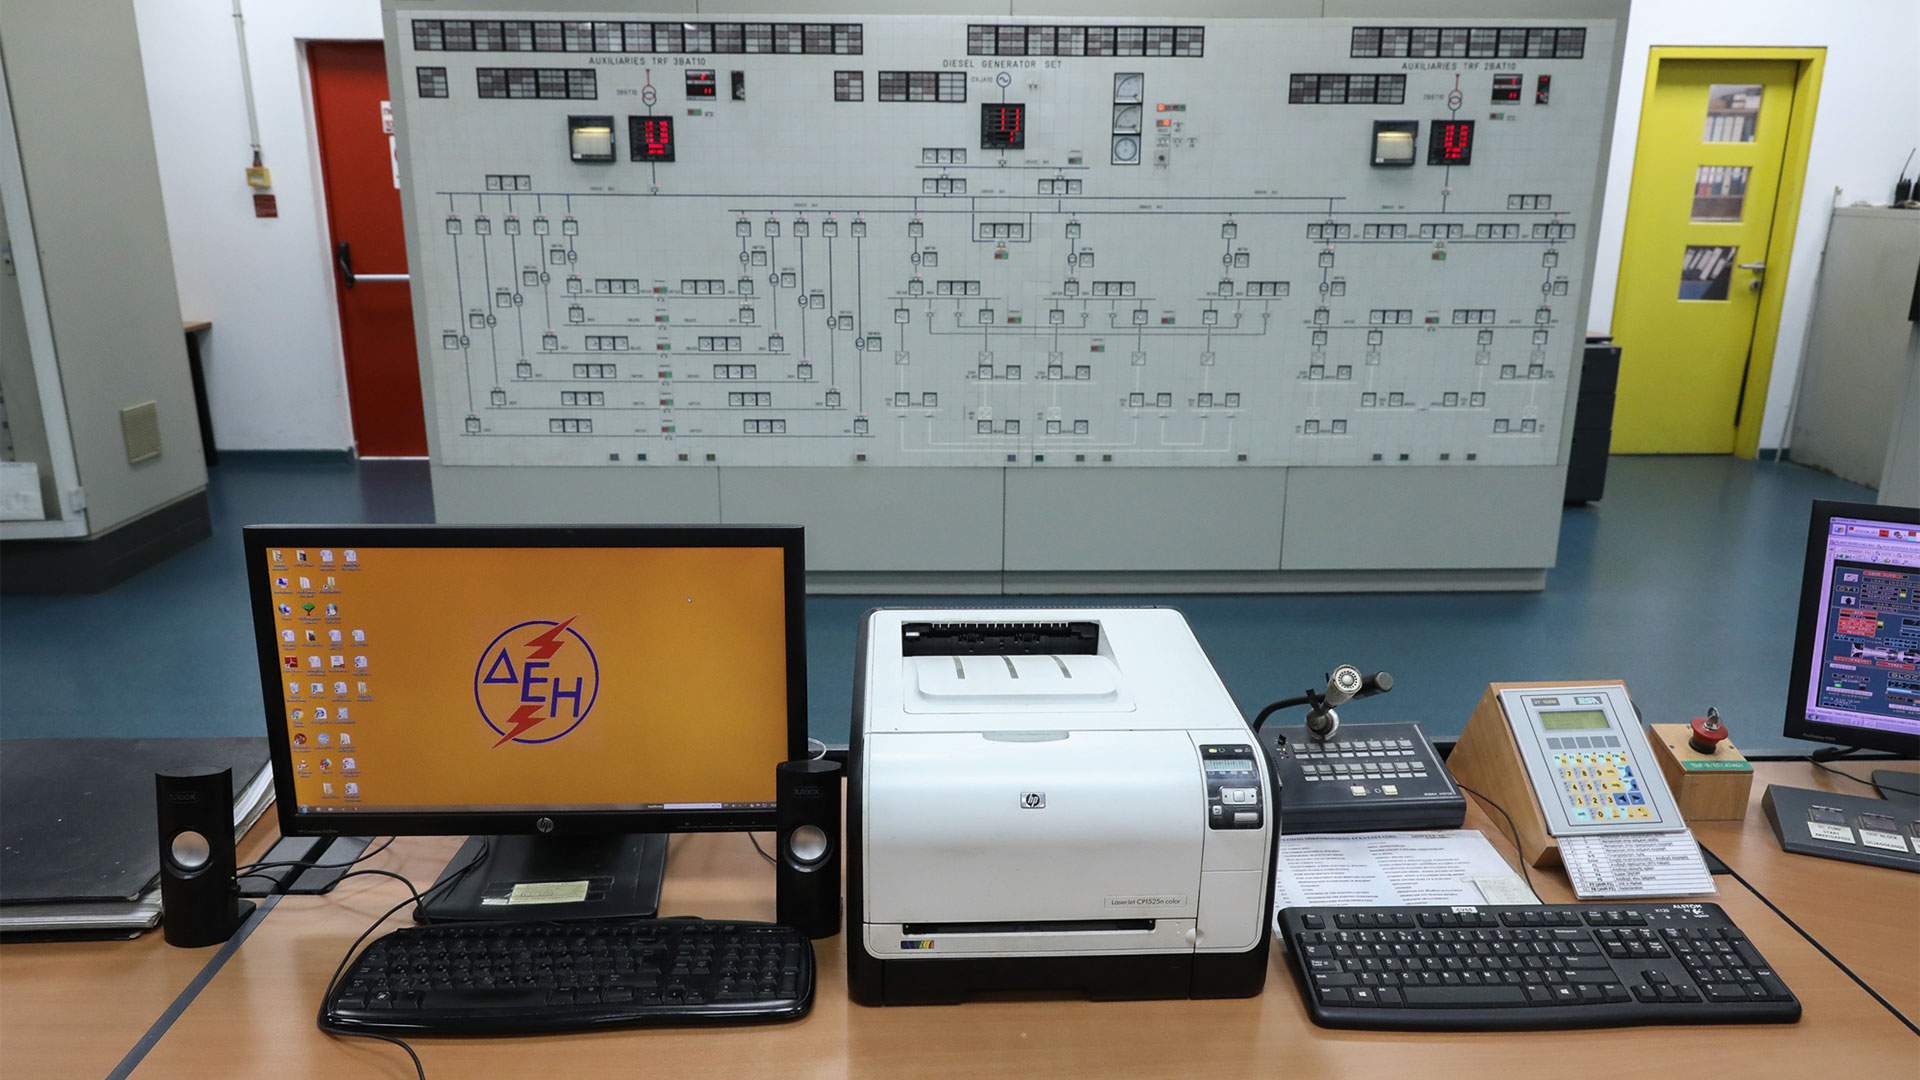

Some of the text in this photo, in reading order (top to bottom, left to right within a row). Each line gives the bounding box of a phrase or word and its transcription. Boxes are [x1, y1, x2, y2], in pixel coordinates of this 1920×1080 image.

[588, 57, 706, 66] AUXILIARIES TRF 3BAT10
[942, 59, 1062, 68] DIESEL GENERATOR SET
[1402, 62, 1517, 70] AUXILIARIES TRF 2BAT10
[536, 817, 554, 832] hp
